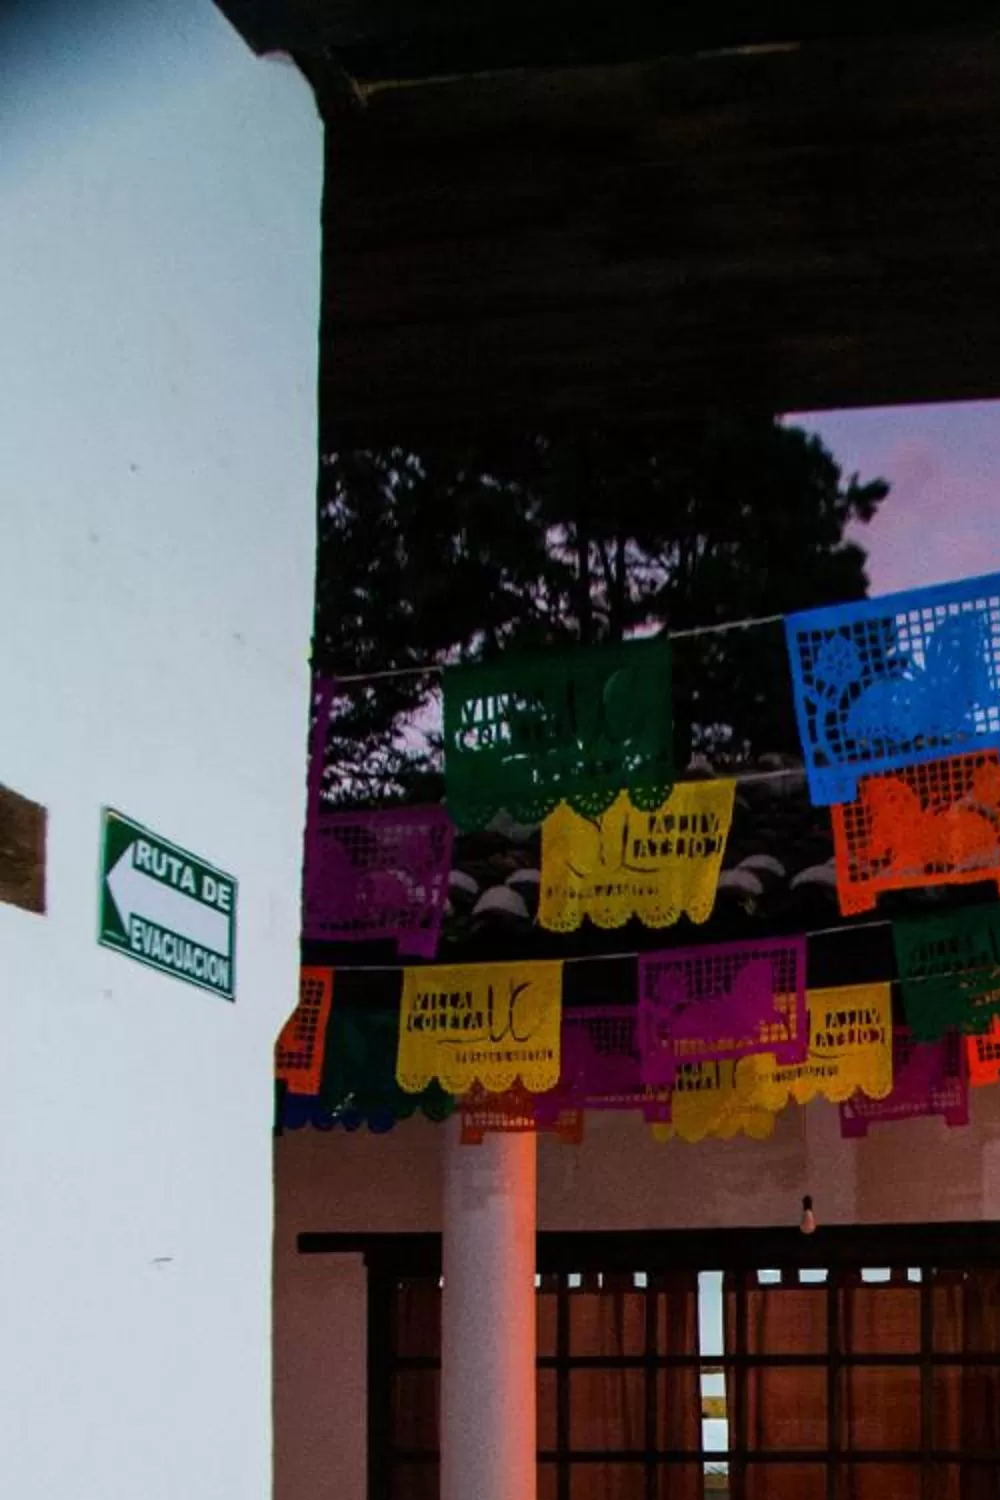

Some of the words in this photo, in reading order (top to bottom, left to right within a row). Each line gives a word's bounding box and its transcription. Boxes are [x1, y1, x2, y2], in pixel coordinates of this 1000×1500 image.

[135, 839, 197, 895] RUTA
[202, 875, 232, 911] DE
[130, 917, 230, 990] EVACUACION
